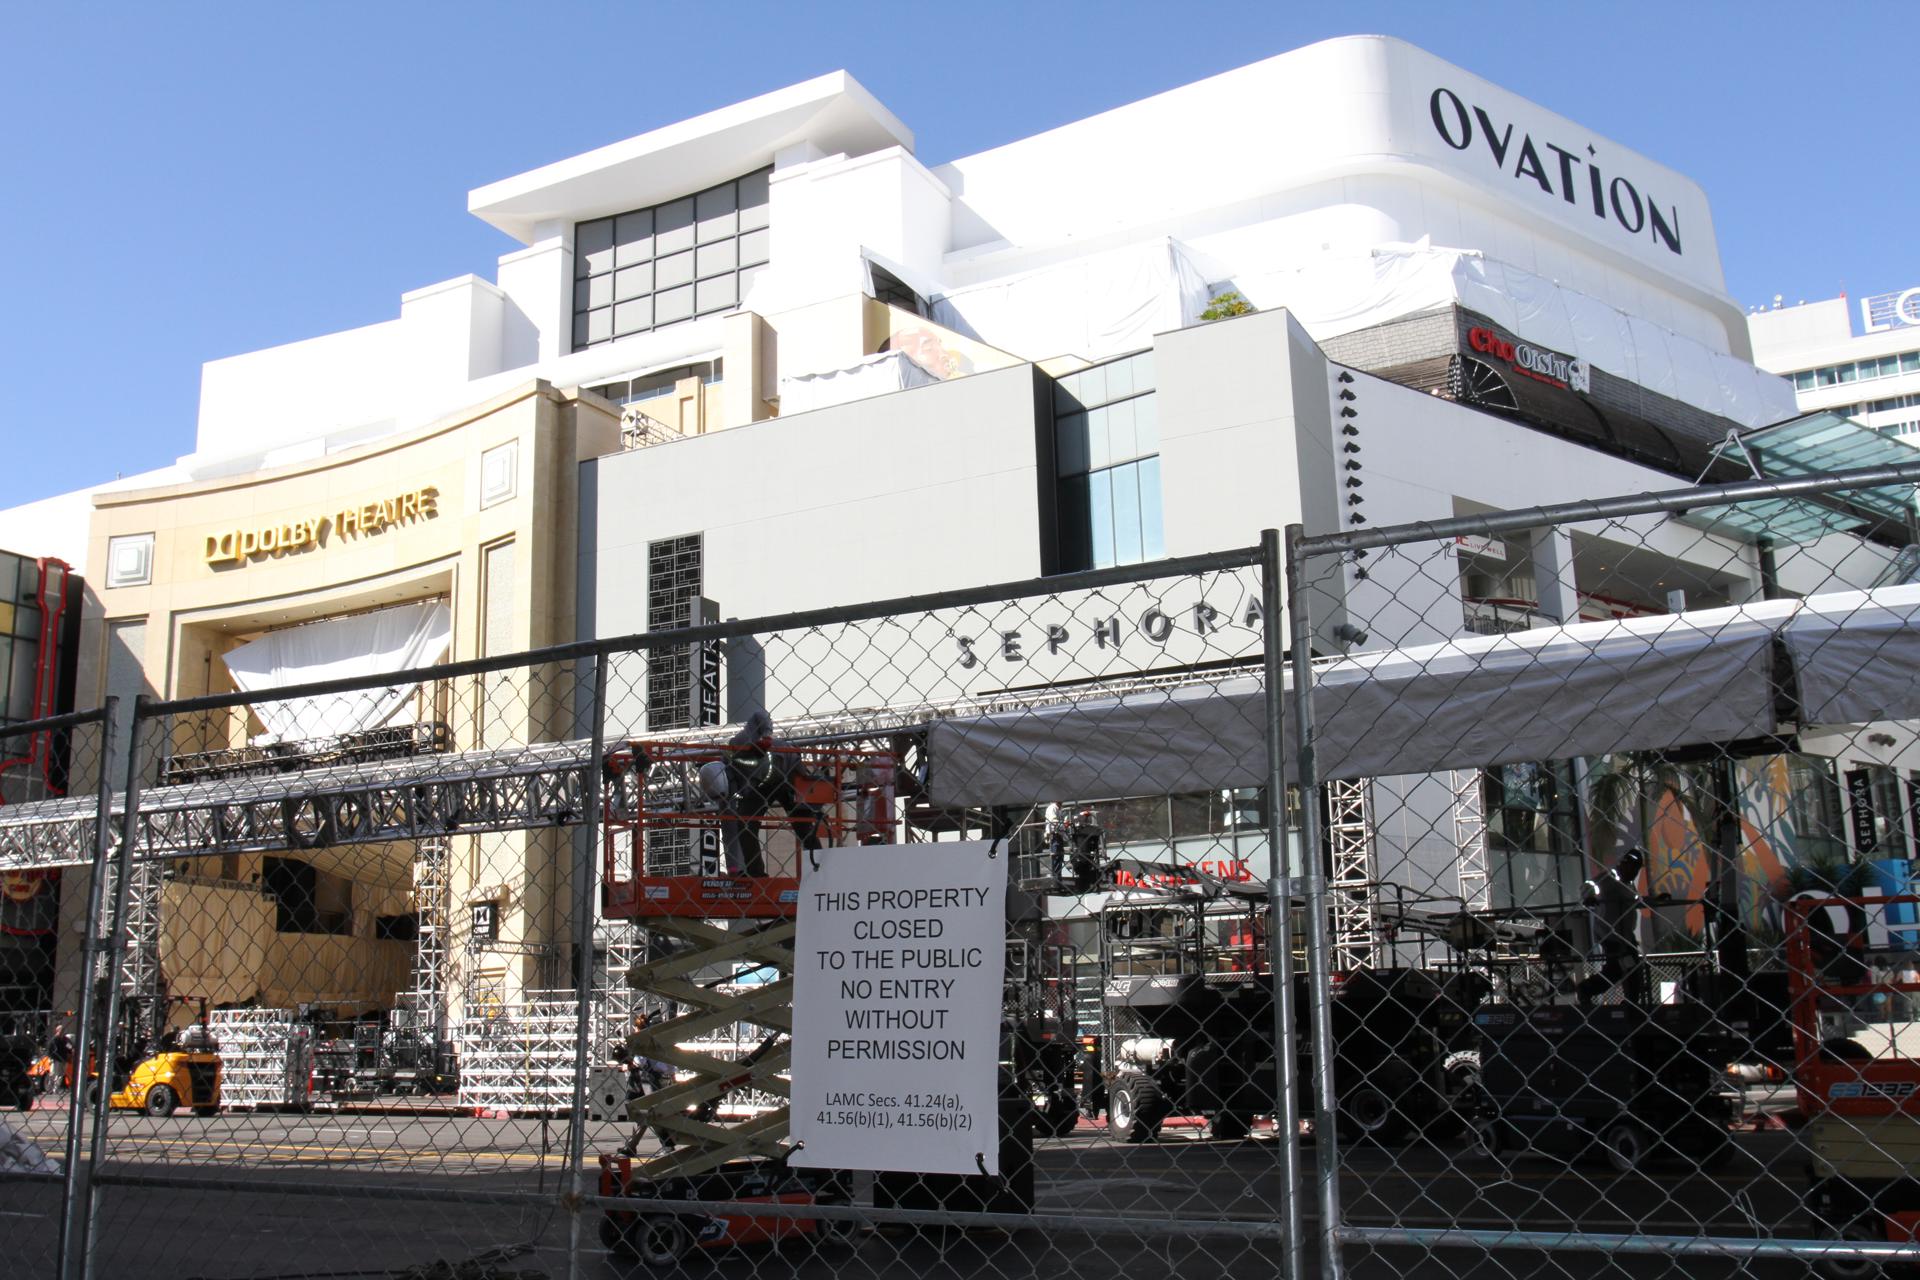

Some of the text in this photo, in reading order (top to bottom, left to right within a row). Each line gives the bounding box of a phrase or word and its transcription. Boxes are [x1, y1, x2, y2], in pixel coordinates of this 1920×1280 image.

[1468, 326, 1515, 362] Cho
[1515, 344, 1569, 382] Oishi
[240, 485, 439, 554] DOLBY THEATRE
[956, 594, 1264, 669] SEPHORA
[1854, 778, 1872, 847] SEPHORA
[814, 887, 990, 911] THIS PROPERTY
[853, 919, 943, 940] CLOSED
[816, 948, 983, 970] TO THE PUBLIC
[841, 979, 956, 999] NO ENTRY
[845, 1009, 949, 1029] WITHOUT
[827, 1040, 965, 1060] PERMISSION
[1828, 1082, 1916, 1098] ES1932
[826, 1092, 964, 1111] LAMC Secs. 41.24(a),
[816, 1111, 972, 1131] 41.56(b)(1), 41.56(b)(2)
